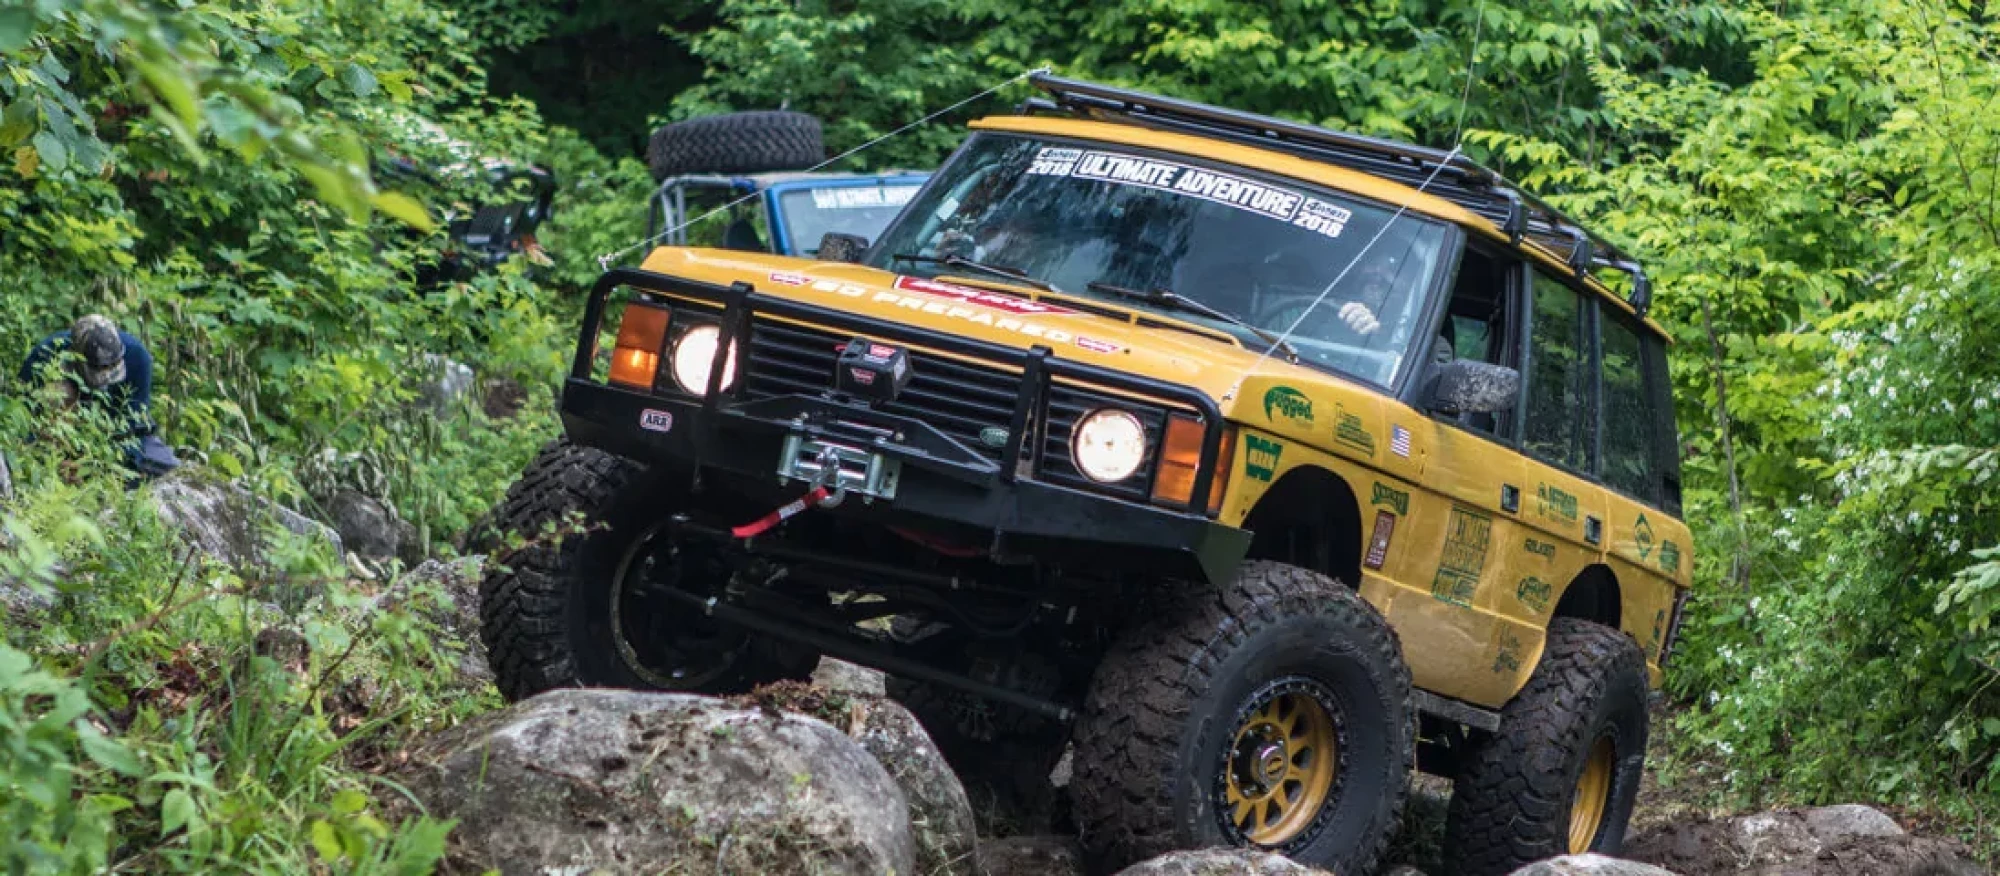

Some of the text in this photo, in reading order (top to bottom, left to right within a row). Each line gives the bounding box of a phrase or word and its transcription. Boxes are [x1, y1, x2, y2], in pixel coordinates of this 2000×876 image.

[1026, 160, 1074, 176] 2018
[1079, 153, 1178, 187] ULTIMATE
[1174, 169, 1298, 216] ADVENTURE
[1293, 211, 1344, 238] 2018
[872, 291, 1072, 343] PREPARED
